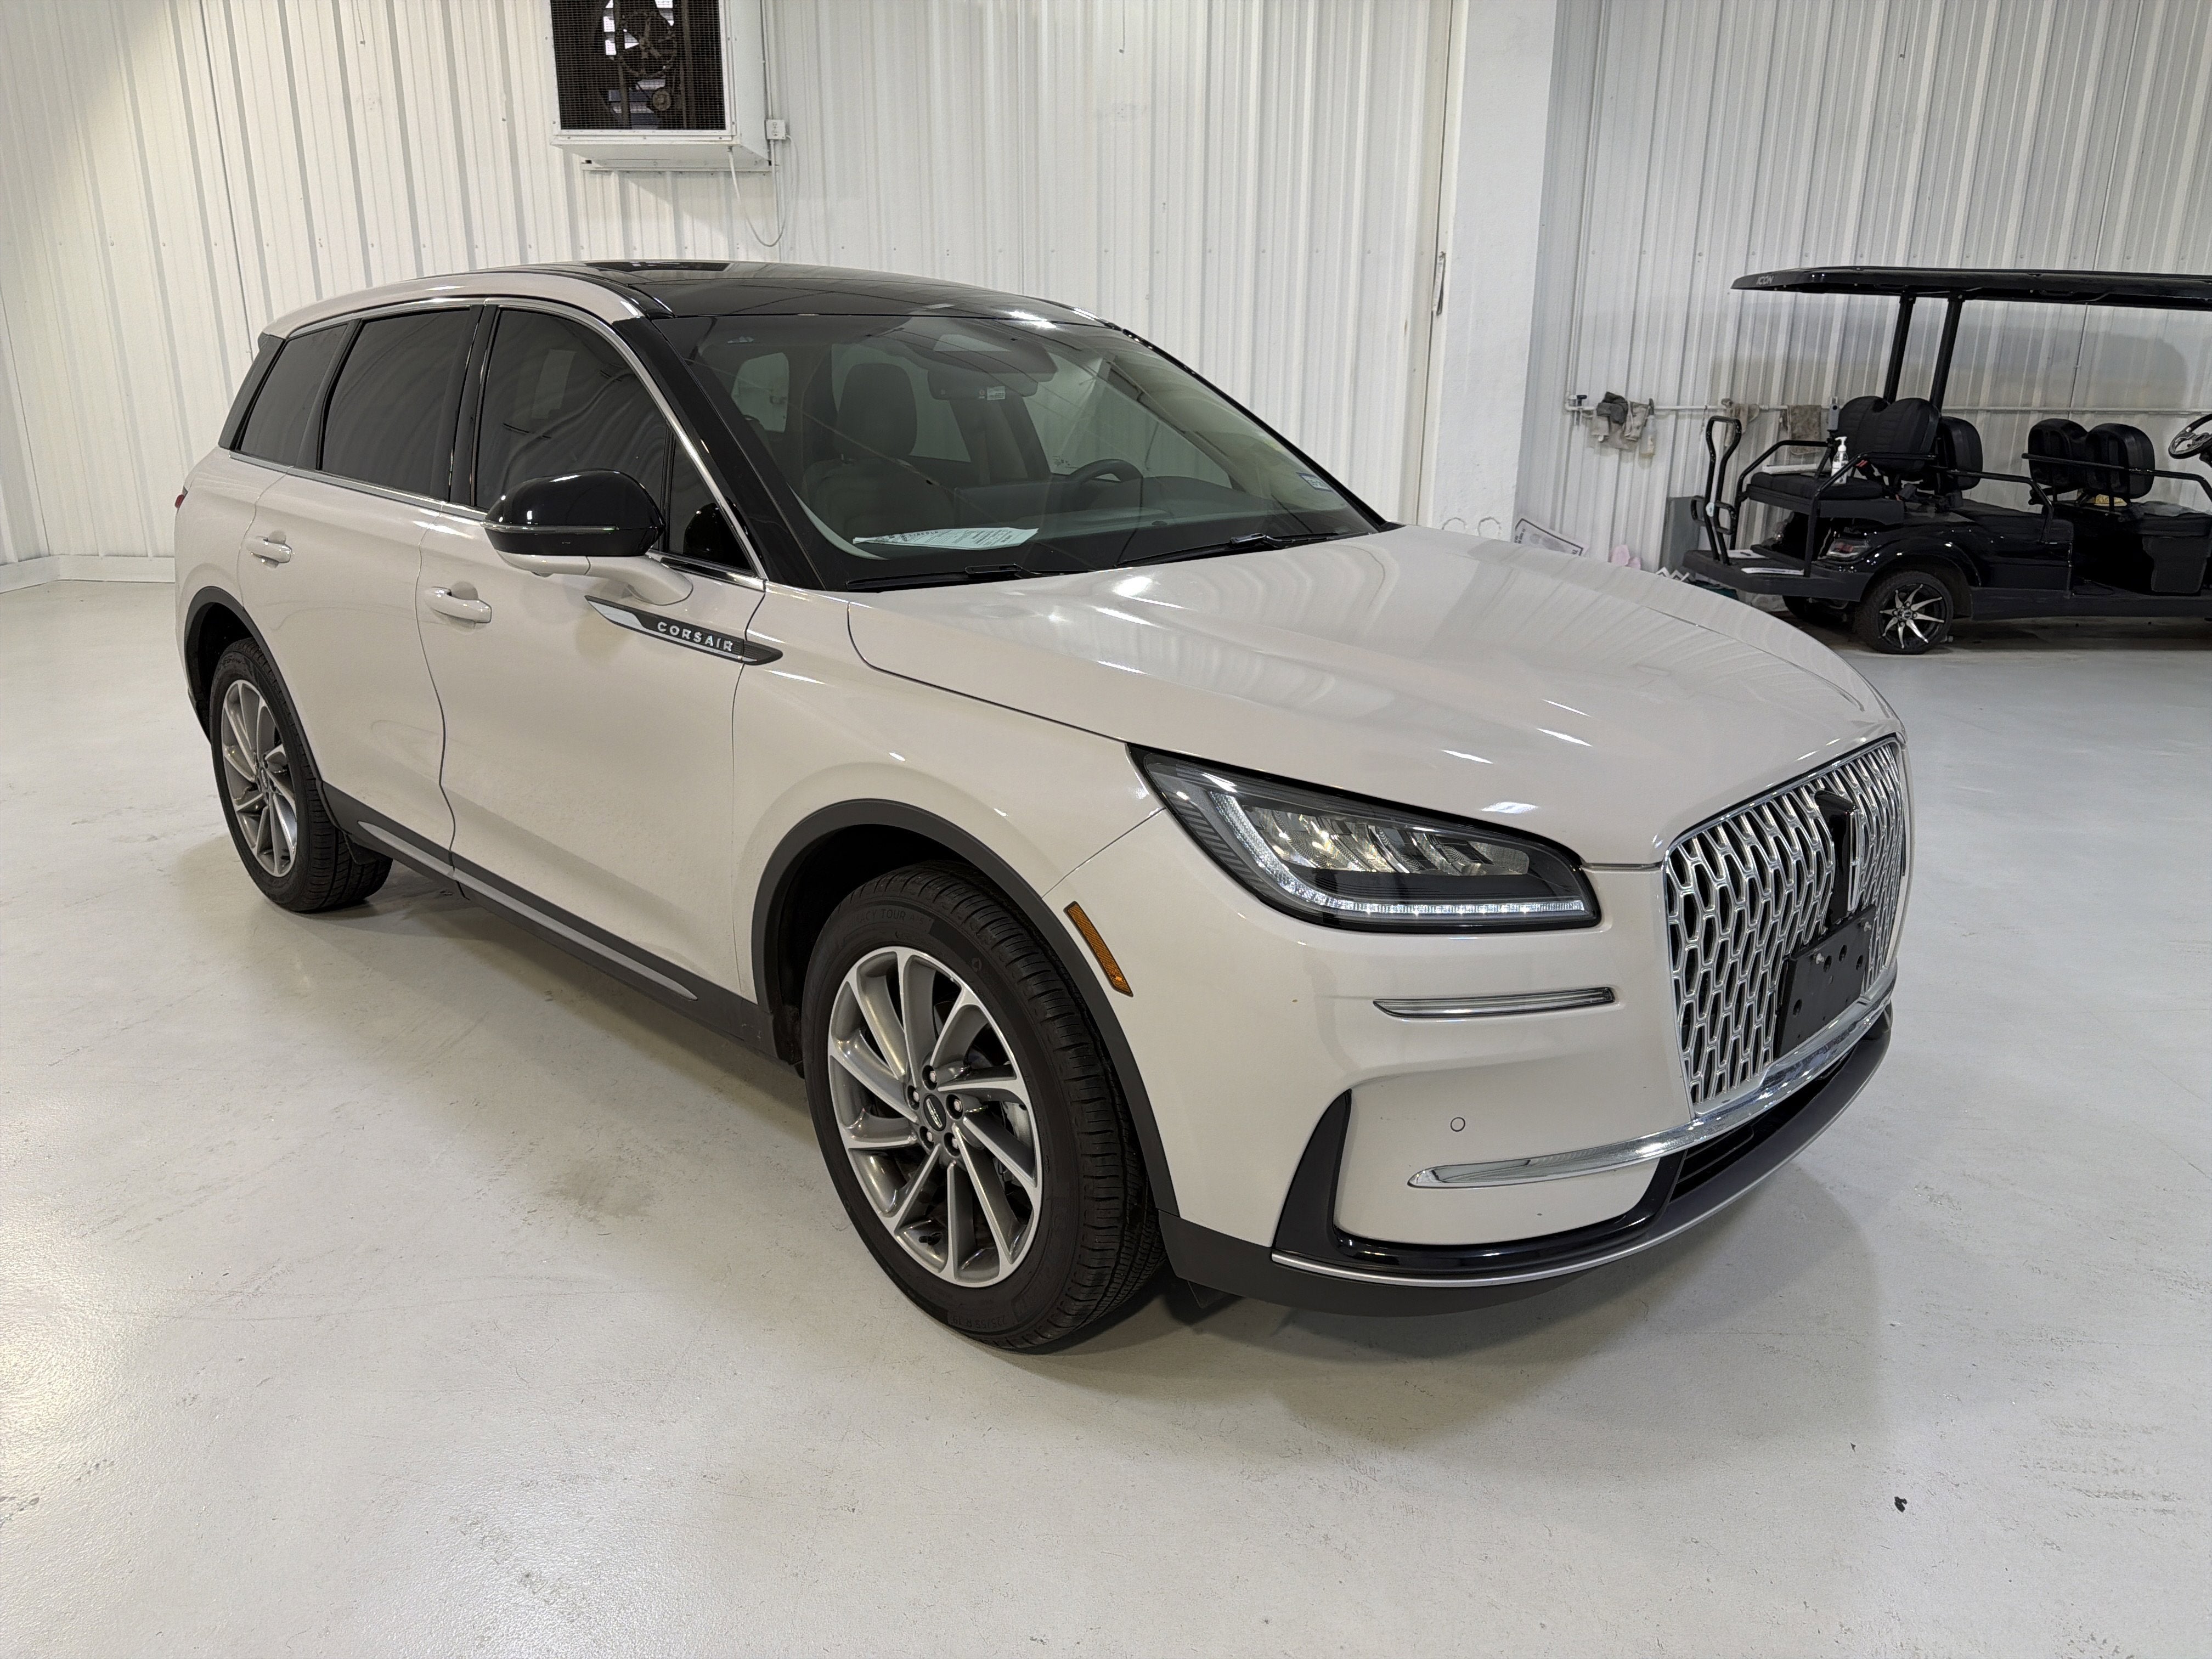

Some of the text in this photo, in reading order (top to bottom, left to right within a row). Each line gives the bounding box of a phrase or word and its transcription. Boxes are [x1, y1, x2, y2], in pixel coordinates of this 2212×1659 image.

[1756, 275, 1774, 285] ICON
[657, 621, 733, 652] CORSAIR
[881, 909, 906, 921] TOUR
